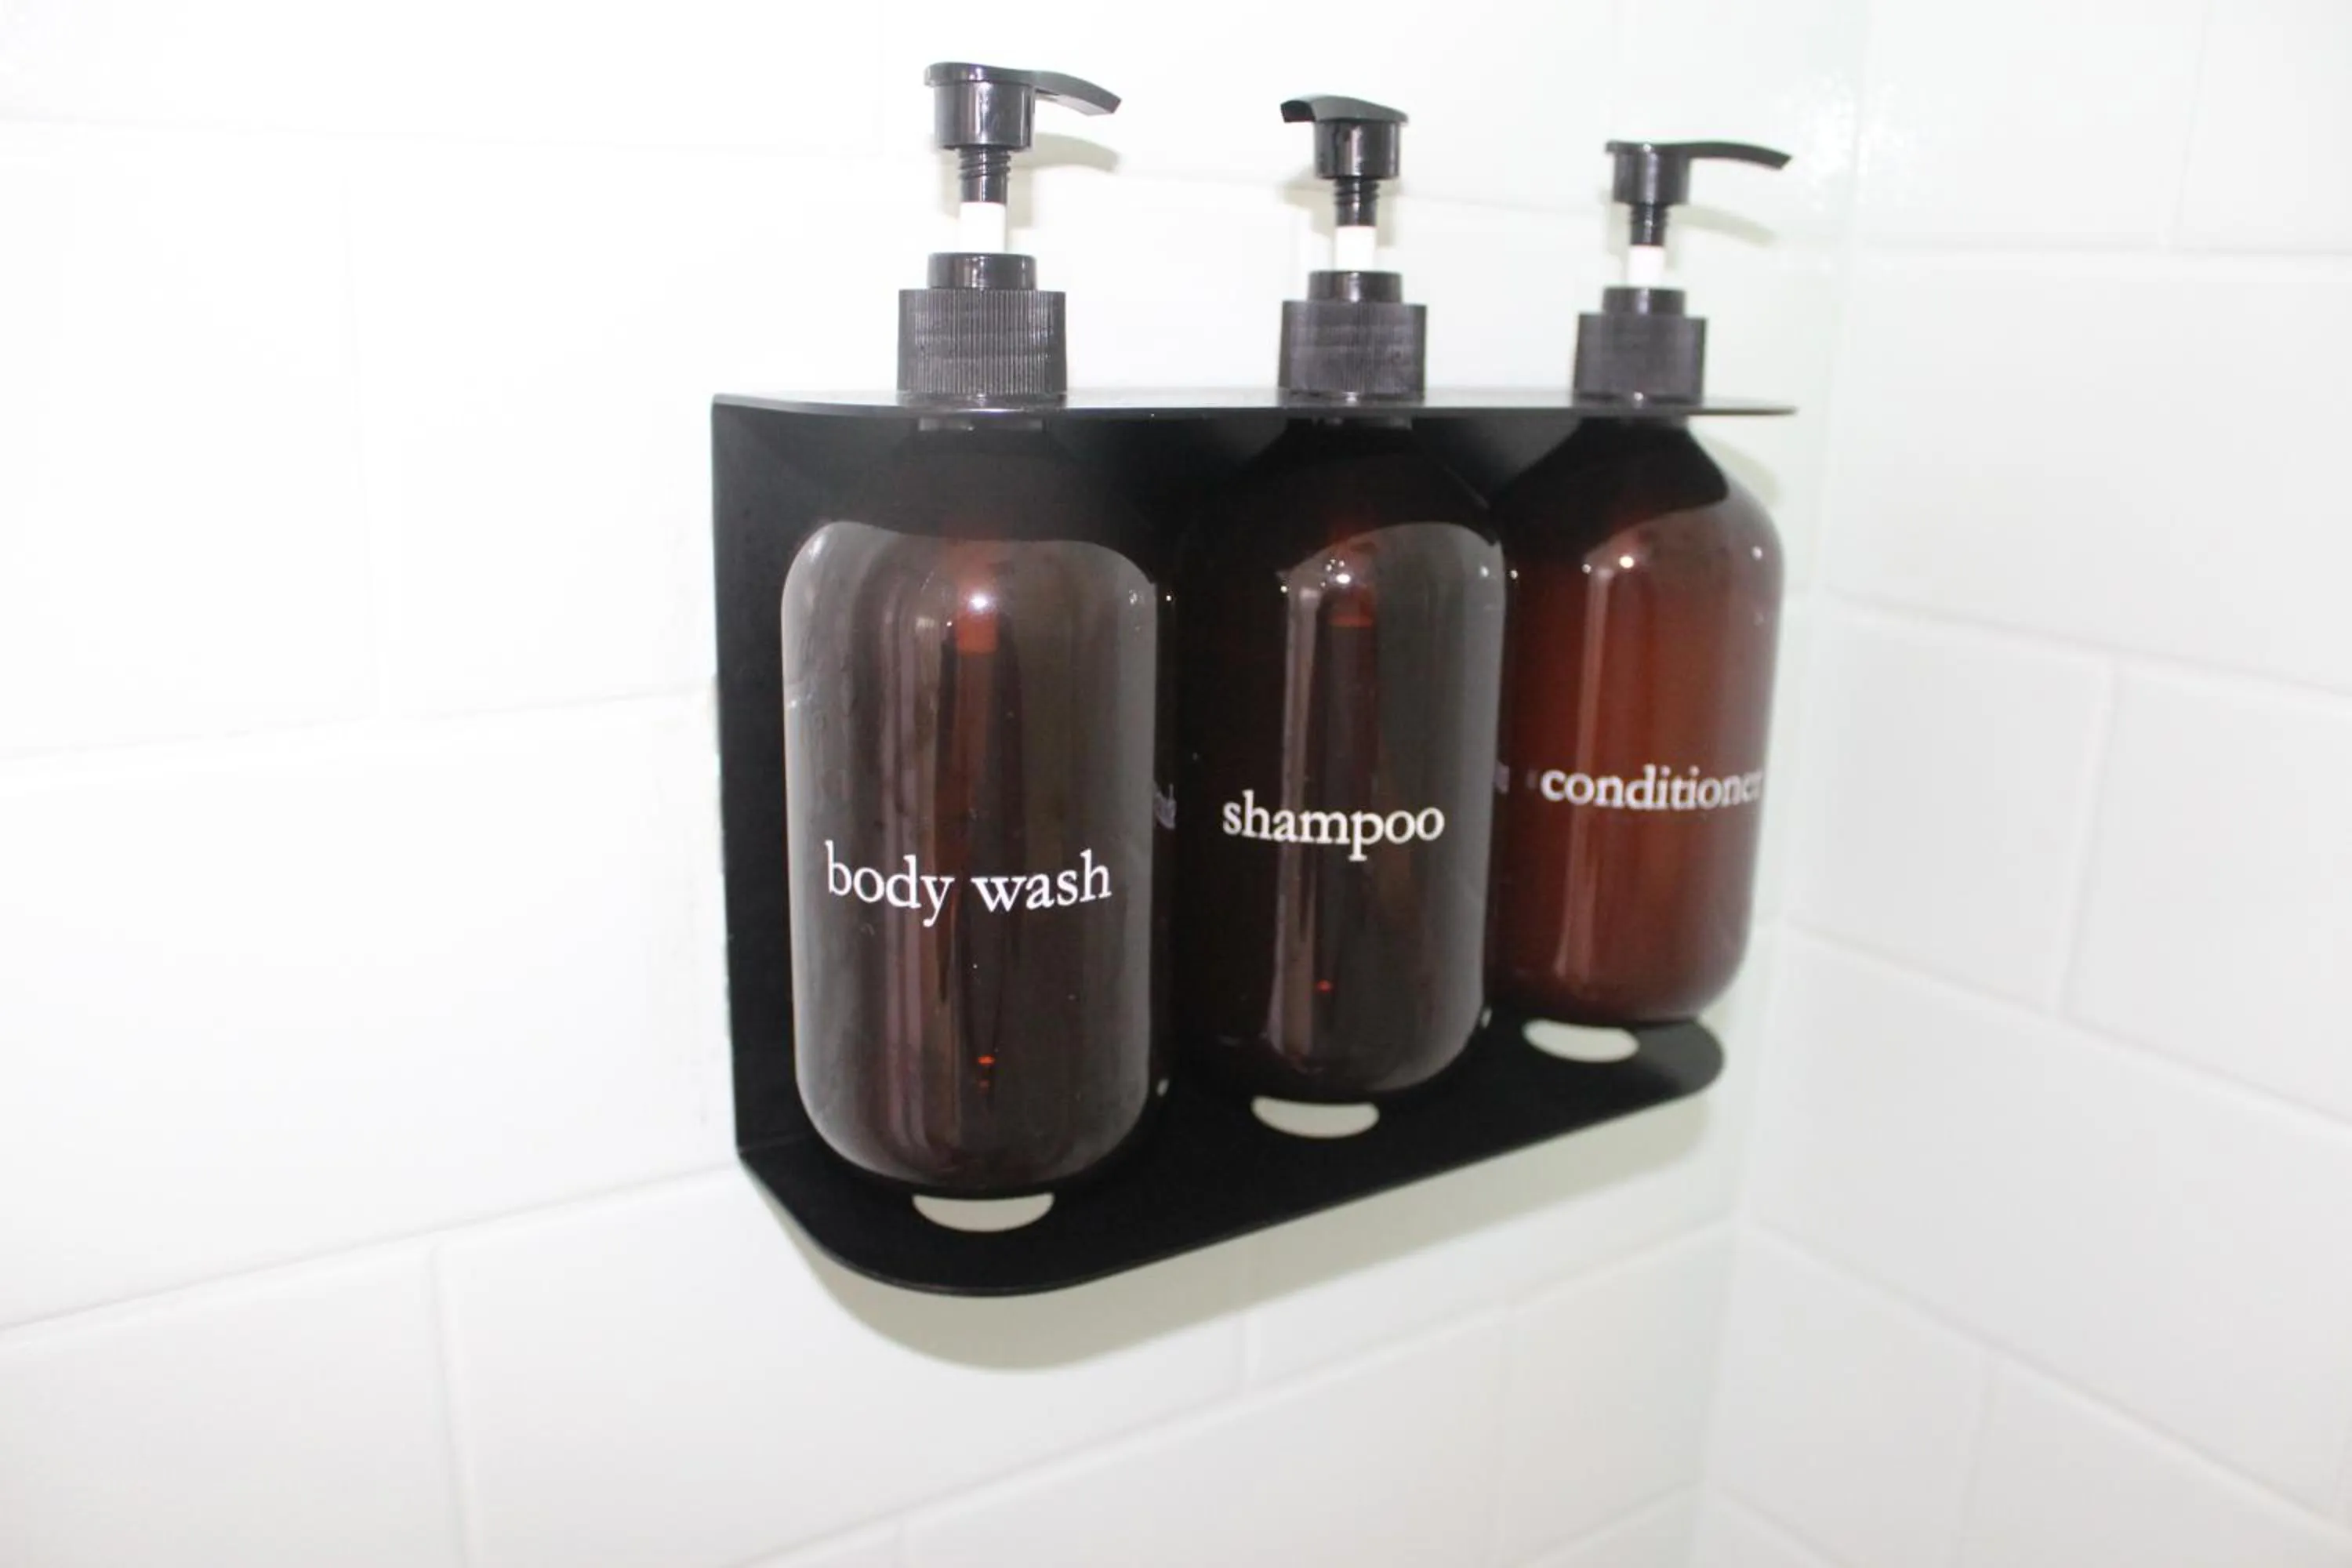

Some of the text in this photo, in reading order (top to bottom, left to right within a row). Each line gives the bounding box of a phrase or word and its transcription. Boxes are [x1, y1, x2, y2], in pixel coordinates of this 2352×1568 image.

[1222, 789, 1445, 862] shampoo
[824, 839, 1112, 927] body wash
